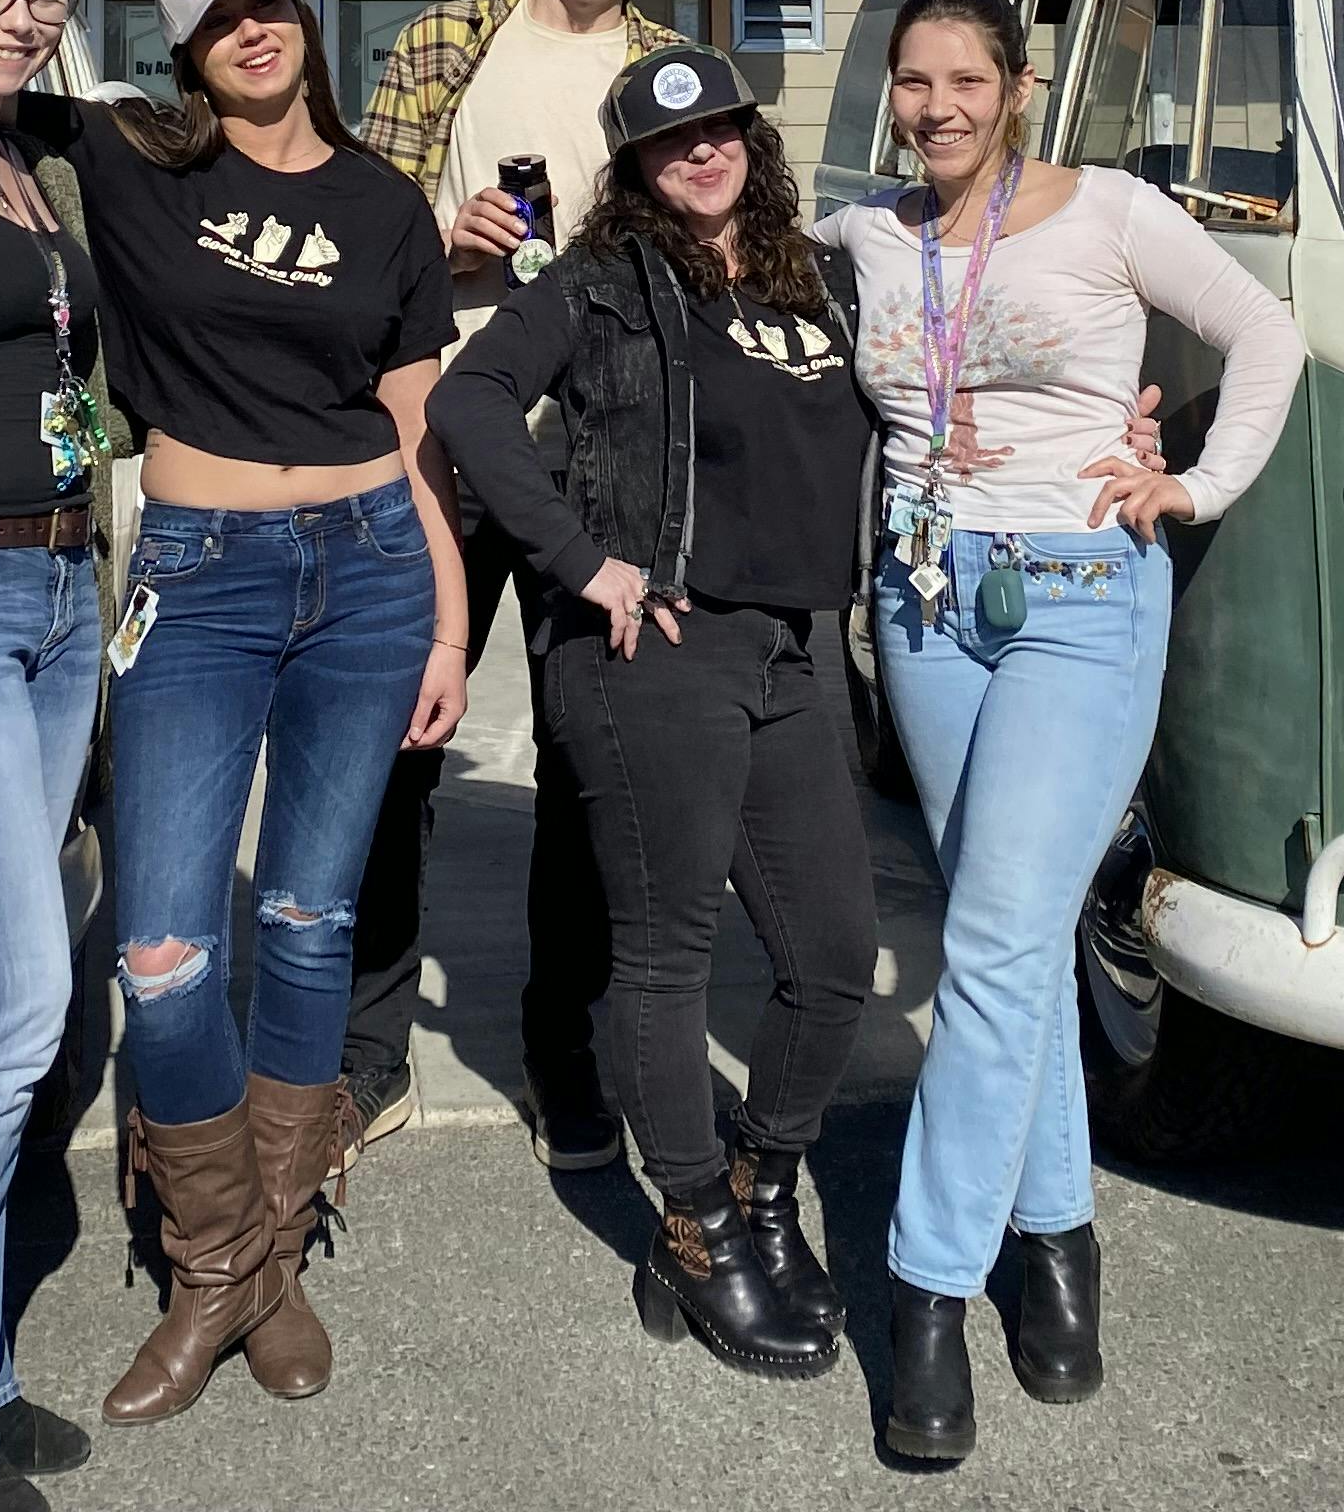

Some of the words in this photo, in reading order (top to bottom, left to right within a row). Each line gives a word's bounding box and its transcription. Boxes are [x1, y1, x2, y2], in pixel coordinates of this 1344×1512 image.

[135, 61, 153, 76] By
[289, 270, 334, 287] Only
[809, 354, 845, 371] Only
